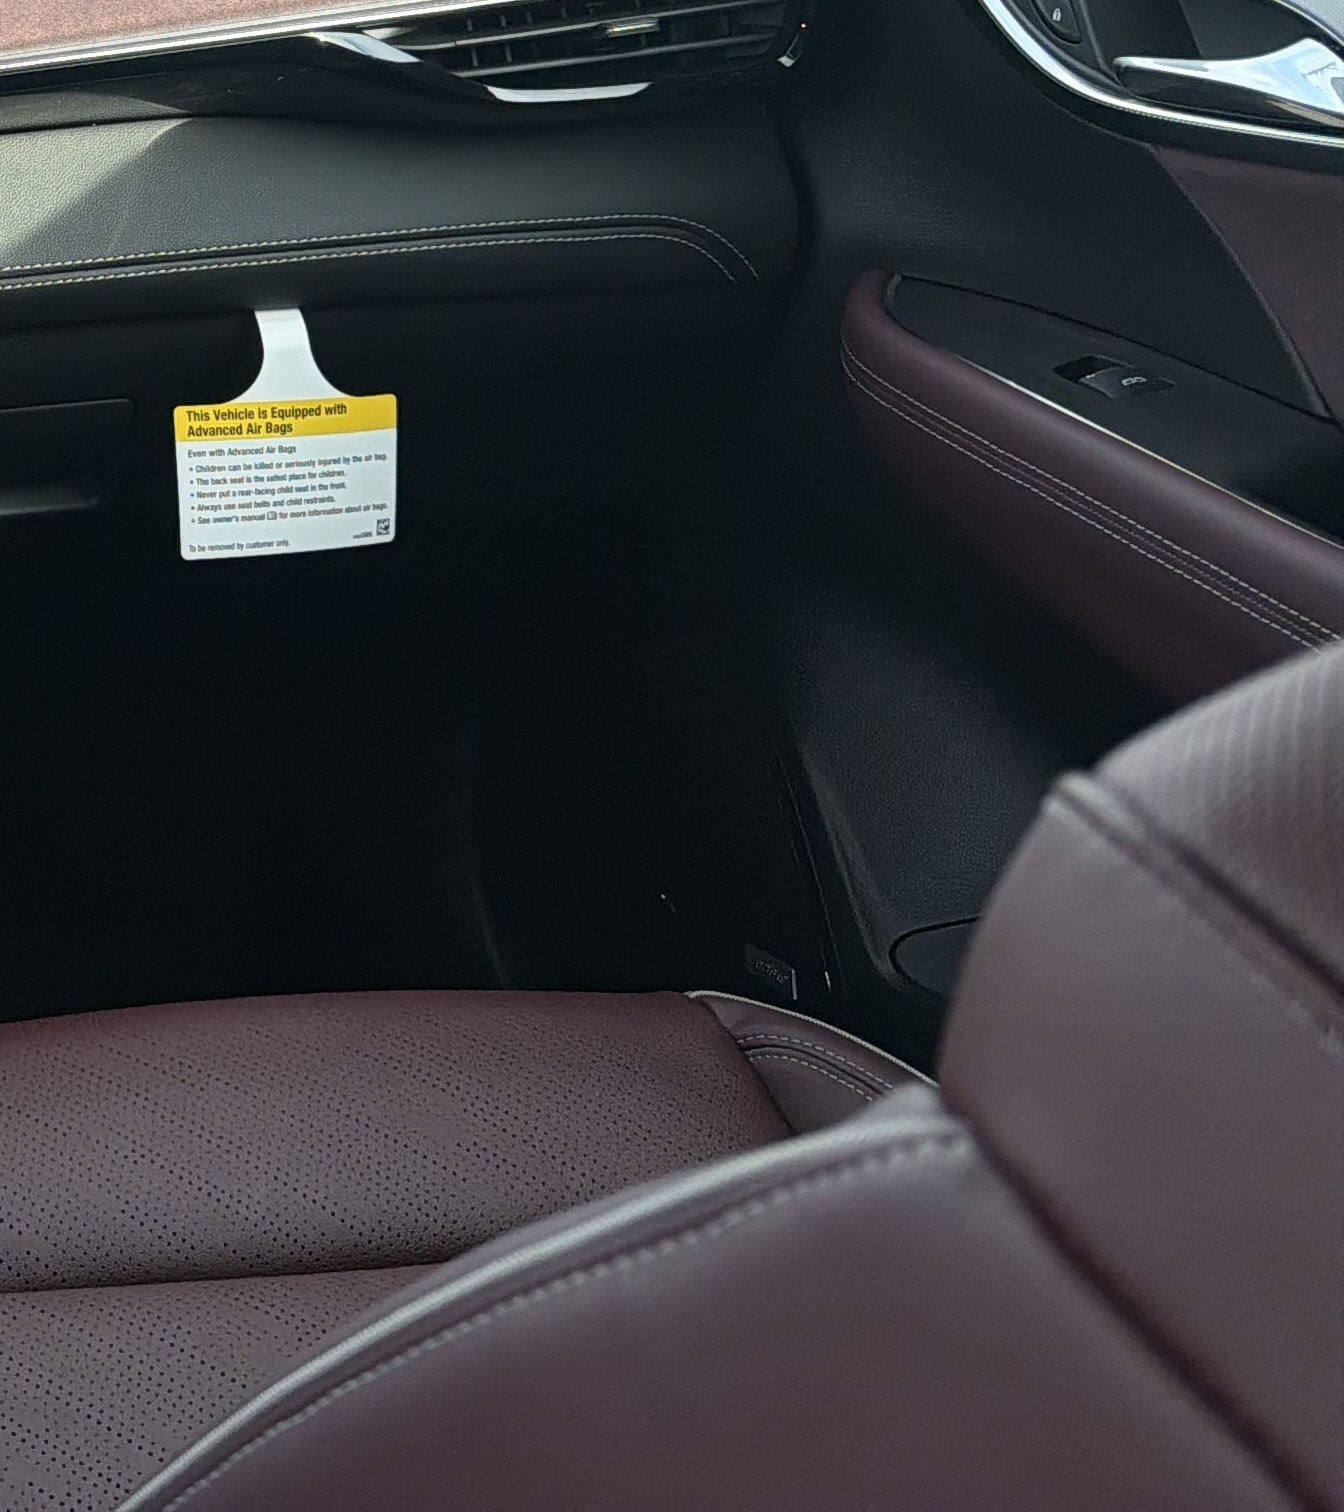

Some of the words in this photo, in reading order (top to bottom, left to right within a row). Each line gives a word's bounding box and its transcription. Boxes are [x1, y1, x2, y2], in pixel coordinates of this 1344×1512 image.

[186, 410, 210, 422] This
[214, 407, 255, 421] Vehicle
[257, 407, 268, 419] is
[271, 406, 321, 419] Equipped
[325, 403, 347, 416] with
[187, 424, 243, 437] Advanced
[246, 424, 262, 435] Air
[266, 423, 293, 435] Bags
[188, 450, 206, 458] Even
[209, 448, 225, 456] with
[227, 447, 263, 456] Advanced
[266, 446, 275, 454] Air
[278, 445, 296, 454] Bags
[195, 464, 226, 473] Children
[243, 462, 252, 470] be
[285, 459, 316, 469] seriously
[318, 457, 340, 467] injured
[343, 456, 350, 465] by
[352, 455, 362, 463] the
[211, 477, 228, 485] back
[230, 476, 244, 484] seat
[289, 472, 306, 482] place
[197, 490, 216, 499] Never
[219, 490, 230, 499] put
[238, 487, 275, 497] rear-facing
[277, 486, 293, 495] child
[318, 483, 328, 491] the
[197, 503, 222, 513] Always
[272, 499, 284, 508] and
[286, 498, 302, 506] child
[241, 513, 265, 522] manual
[279, 511, 288, 519] for
[308, 507, 343, 517] information
[345, 506, 361, 514] about
[189, 544, 196, 553] To
[198, 544, 206, 552] be
[207, 542, 235, 551] removed
[237, 542, 244, 551] by
[246, 540, 274, 549] customer
[276, 539, 290, 549] only.
